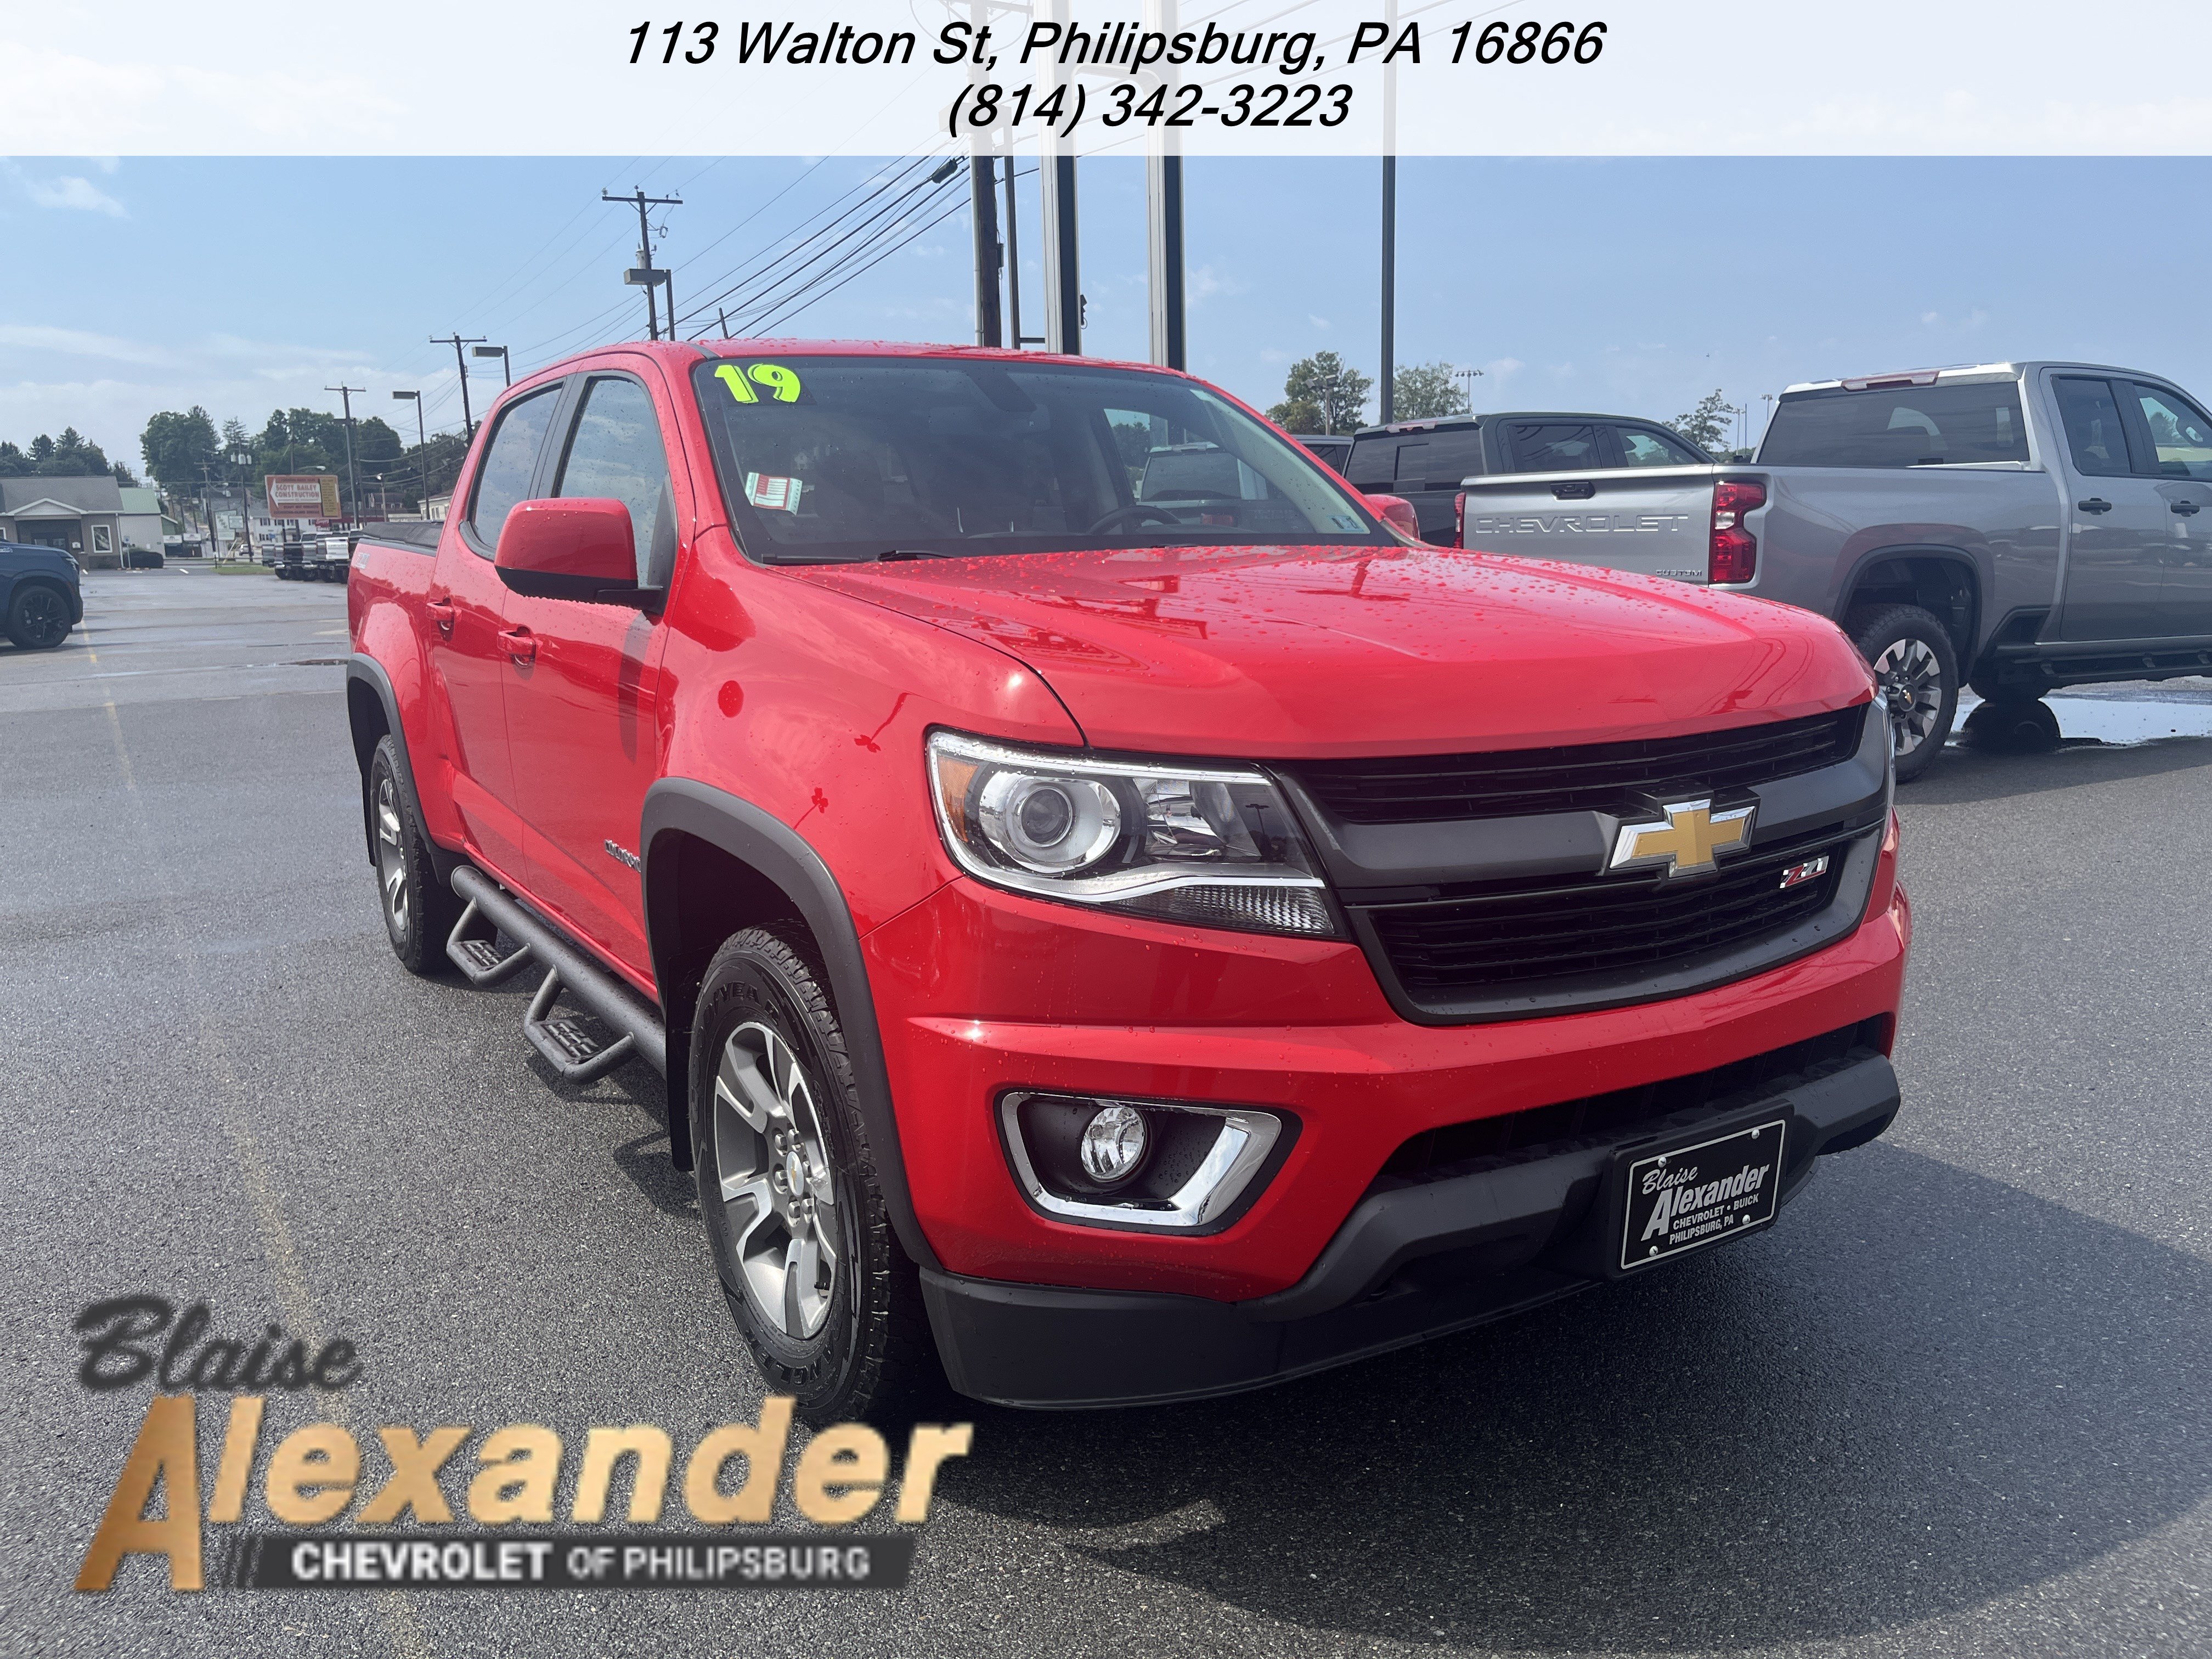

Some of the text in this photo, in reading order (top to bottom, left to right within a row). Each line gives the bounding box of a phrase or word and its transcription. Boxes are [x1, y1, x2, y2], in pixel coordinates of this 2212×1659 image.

[714, 363, 801, 403] 19
[1476, 514, 1689, 533] CHEVROLET
[1779, 855, 1830, 889] Z71
[1641, 1166, 1699, 1195] Blaise
[1640, 1164, 1770, 1242] Alexander
[1673, 1193, 1759, 1230] CHEVROLET BUICK
[1669, 1214, 1734, 1245] PHILIPSBURG, PA
